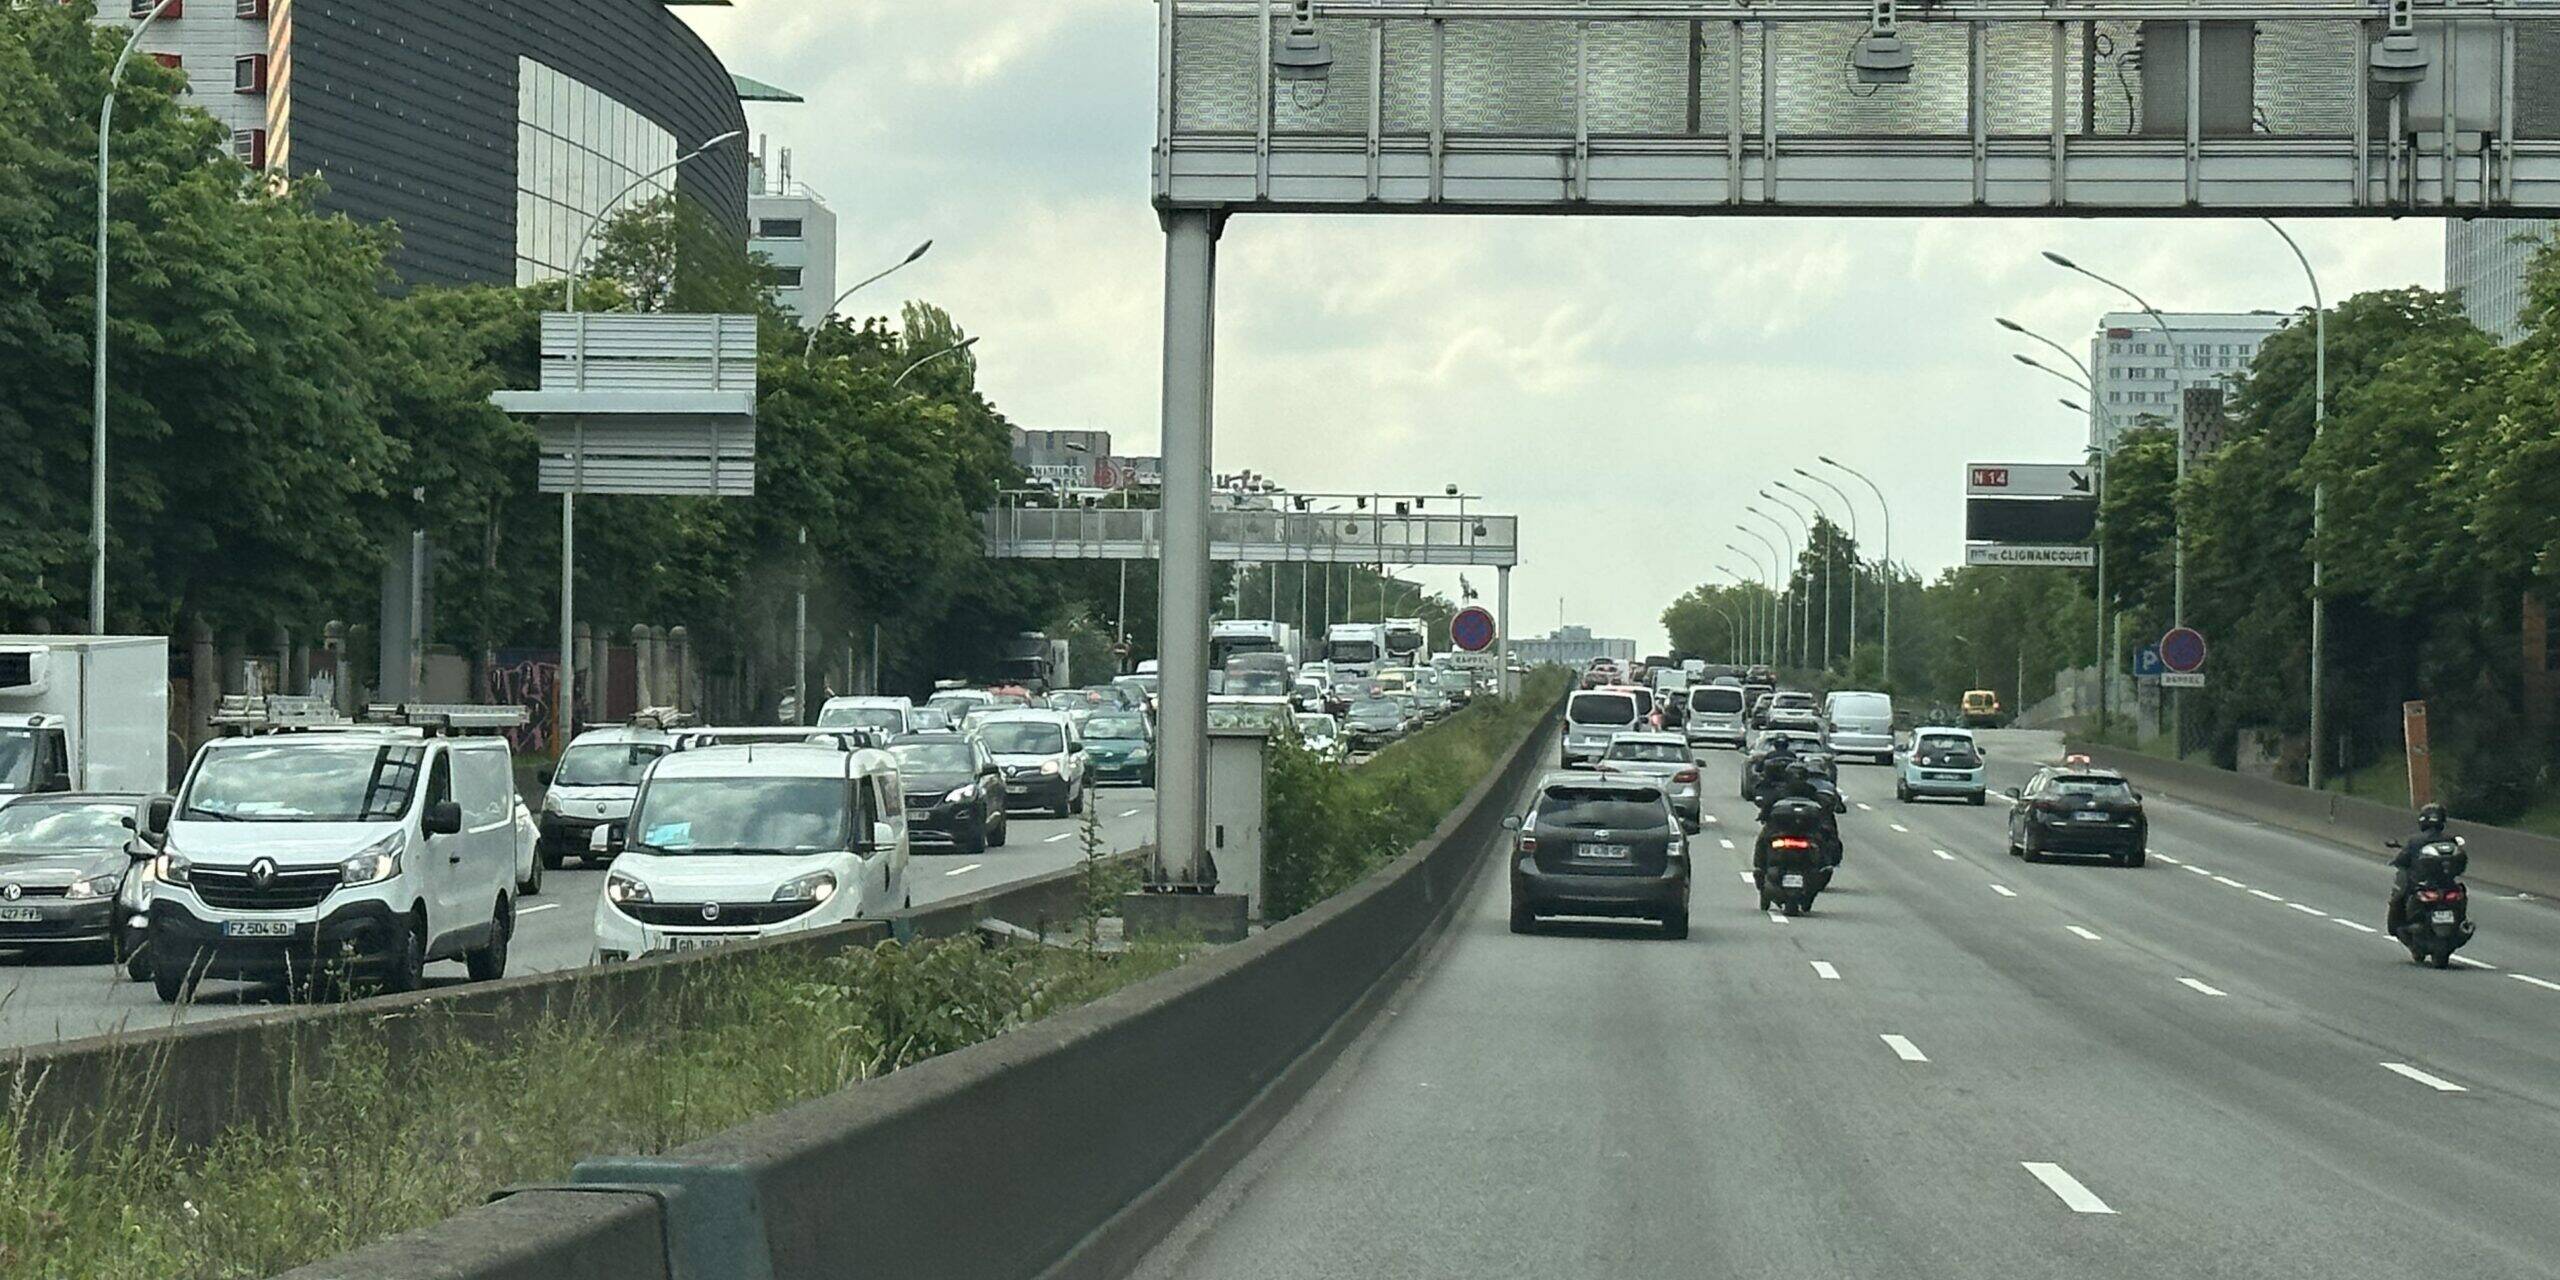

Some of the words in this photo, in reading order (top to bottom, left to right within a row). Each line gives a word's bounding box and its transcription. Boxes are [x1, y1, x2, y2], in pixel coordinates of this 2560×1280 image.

[1974, 470, 1983, 484] N
[1988, 471, 2006, 484] 14
[2000, 550, 2089, 562] CLIGNANCOURT
